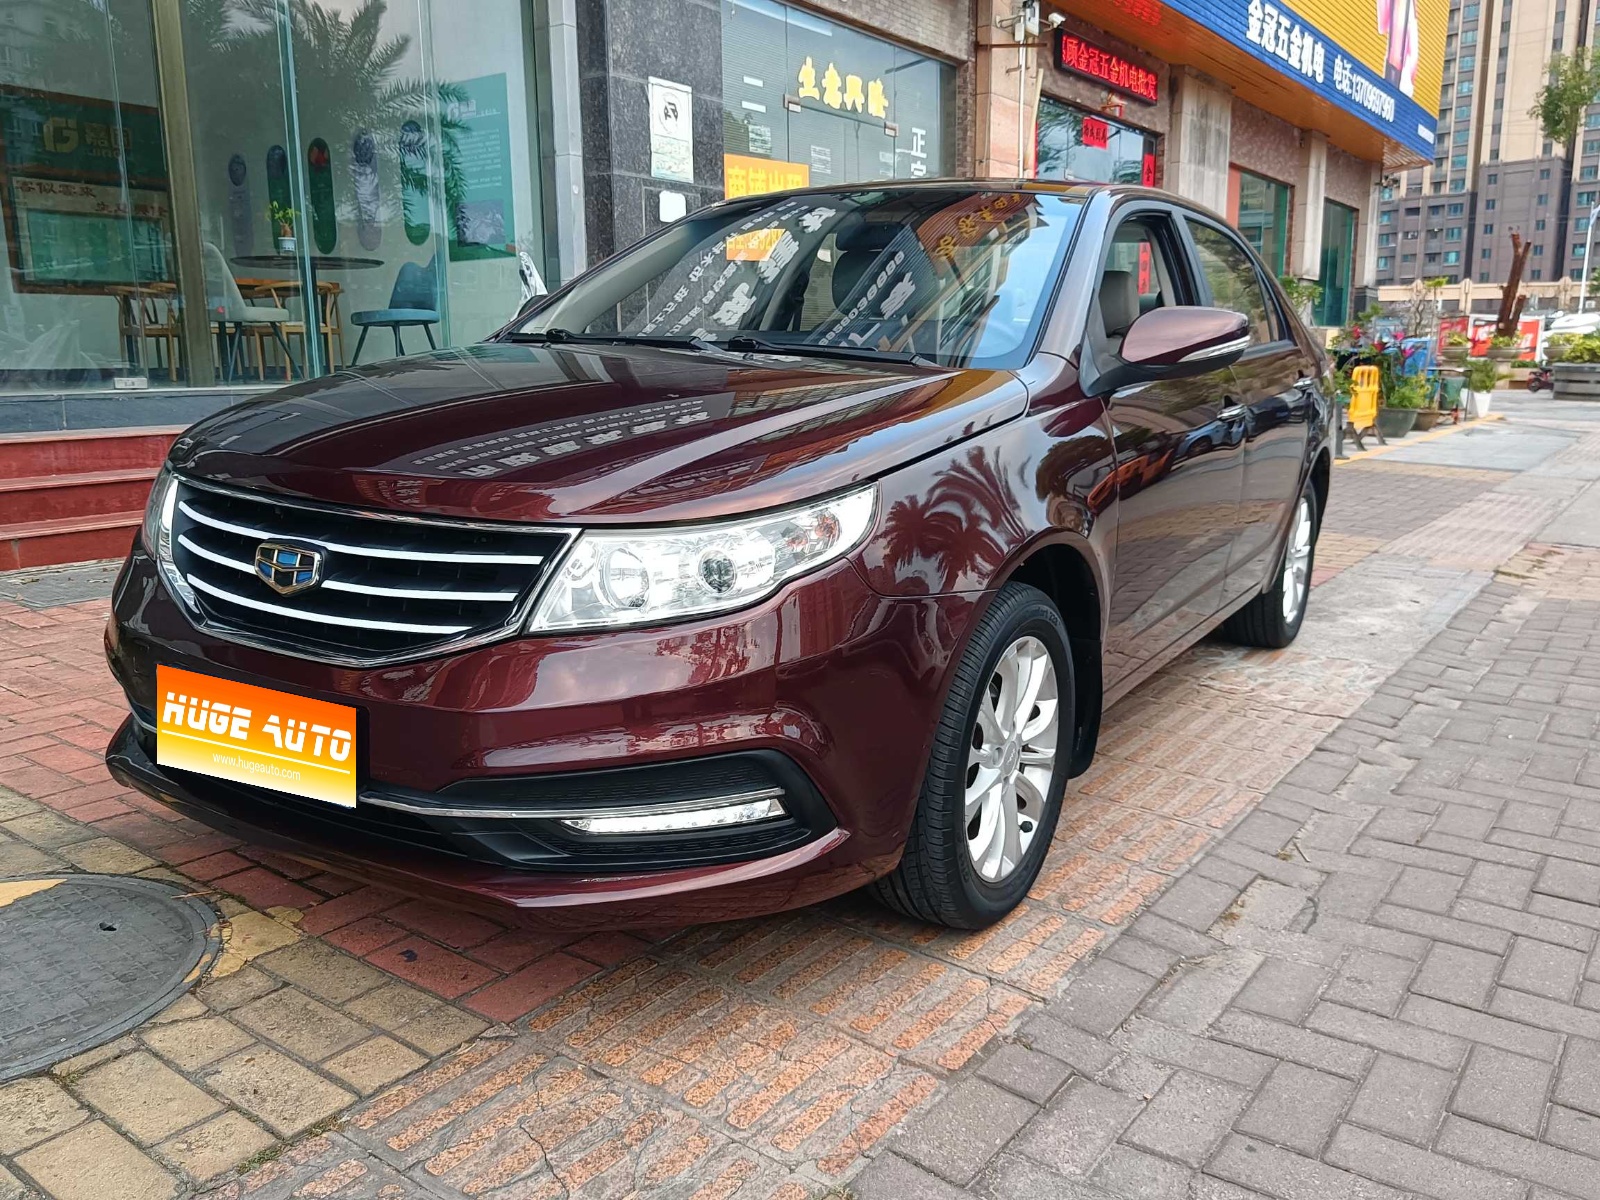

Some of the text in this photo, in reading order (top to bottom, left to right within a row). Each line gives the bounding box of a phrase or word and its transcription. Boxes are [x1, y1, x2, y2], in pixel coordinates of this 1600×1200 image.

[1246, 1, 1325, 84] 金冠五金机电
